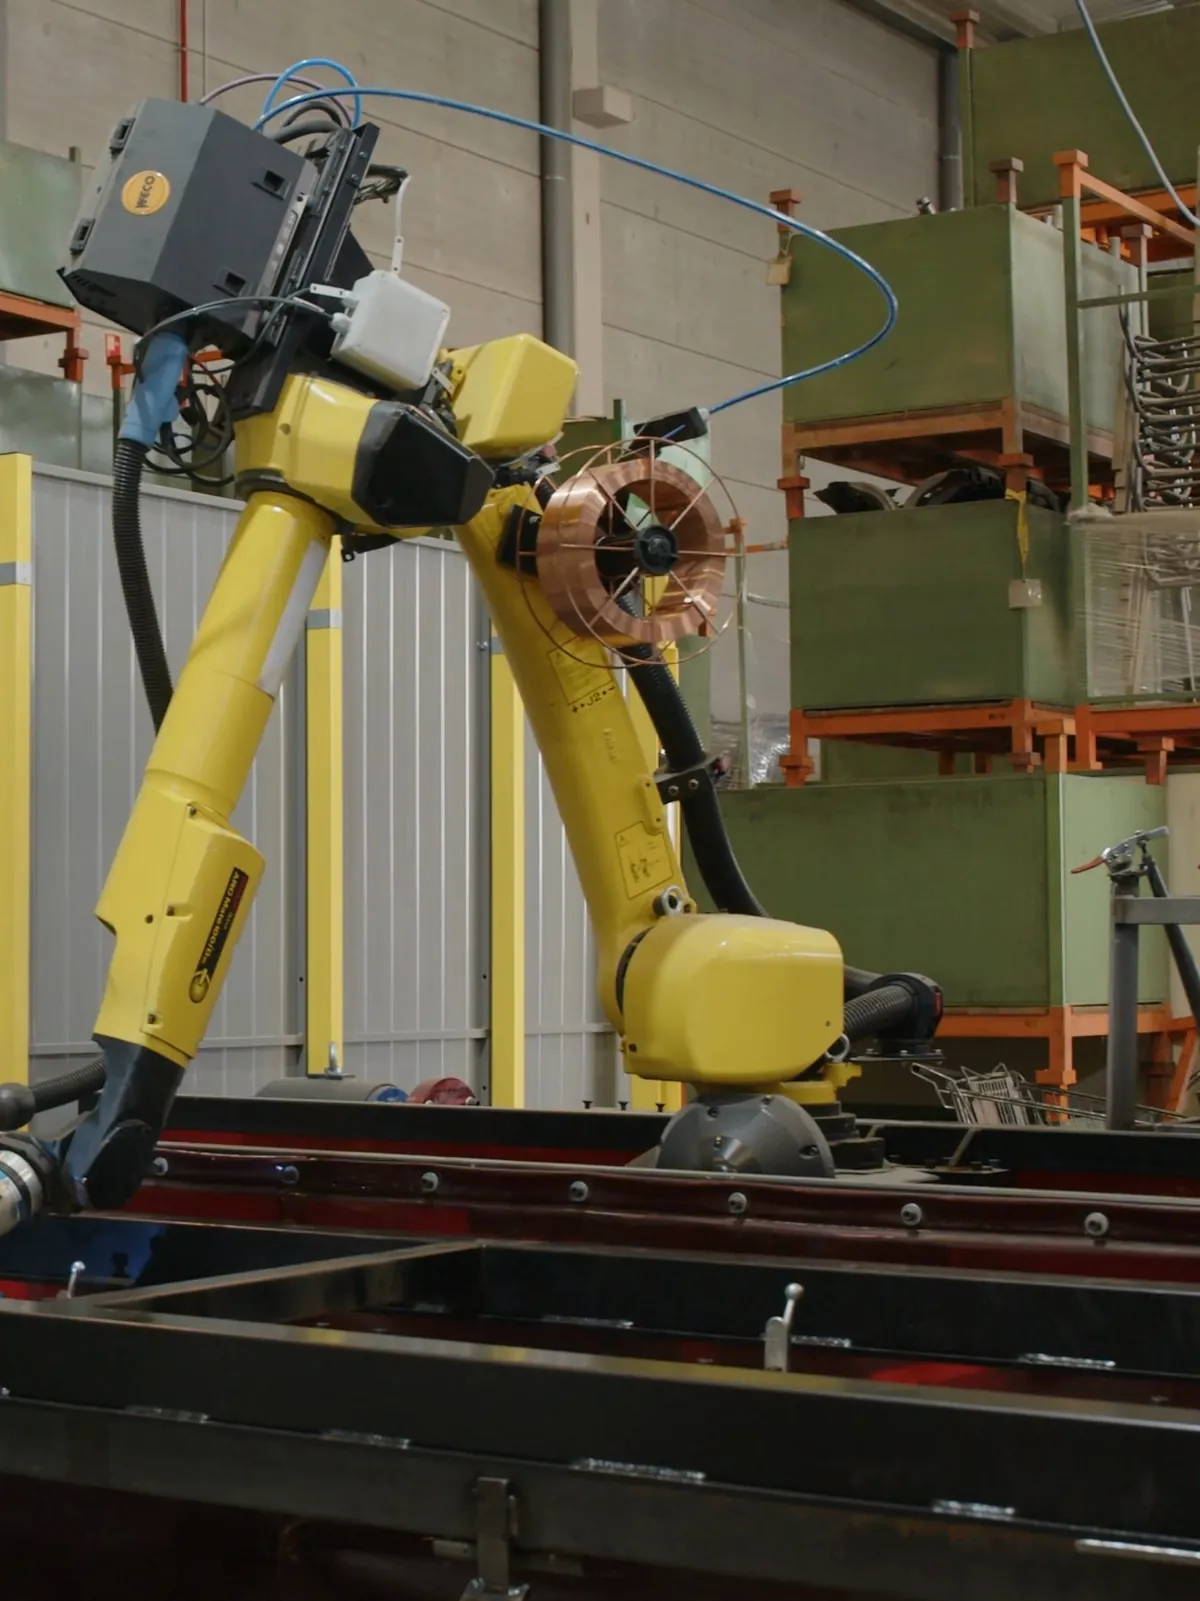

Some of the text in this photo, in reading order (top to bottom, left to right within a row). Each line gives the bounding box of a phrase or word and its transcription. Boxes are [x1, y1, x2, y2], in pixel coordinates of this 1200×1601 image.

[135, 175, 156, 209] WECO
[227, 871, 240, 897] ARC
[216, 896, 231, 925] Mate
